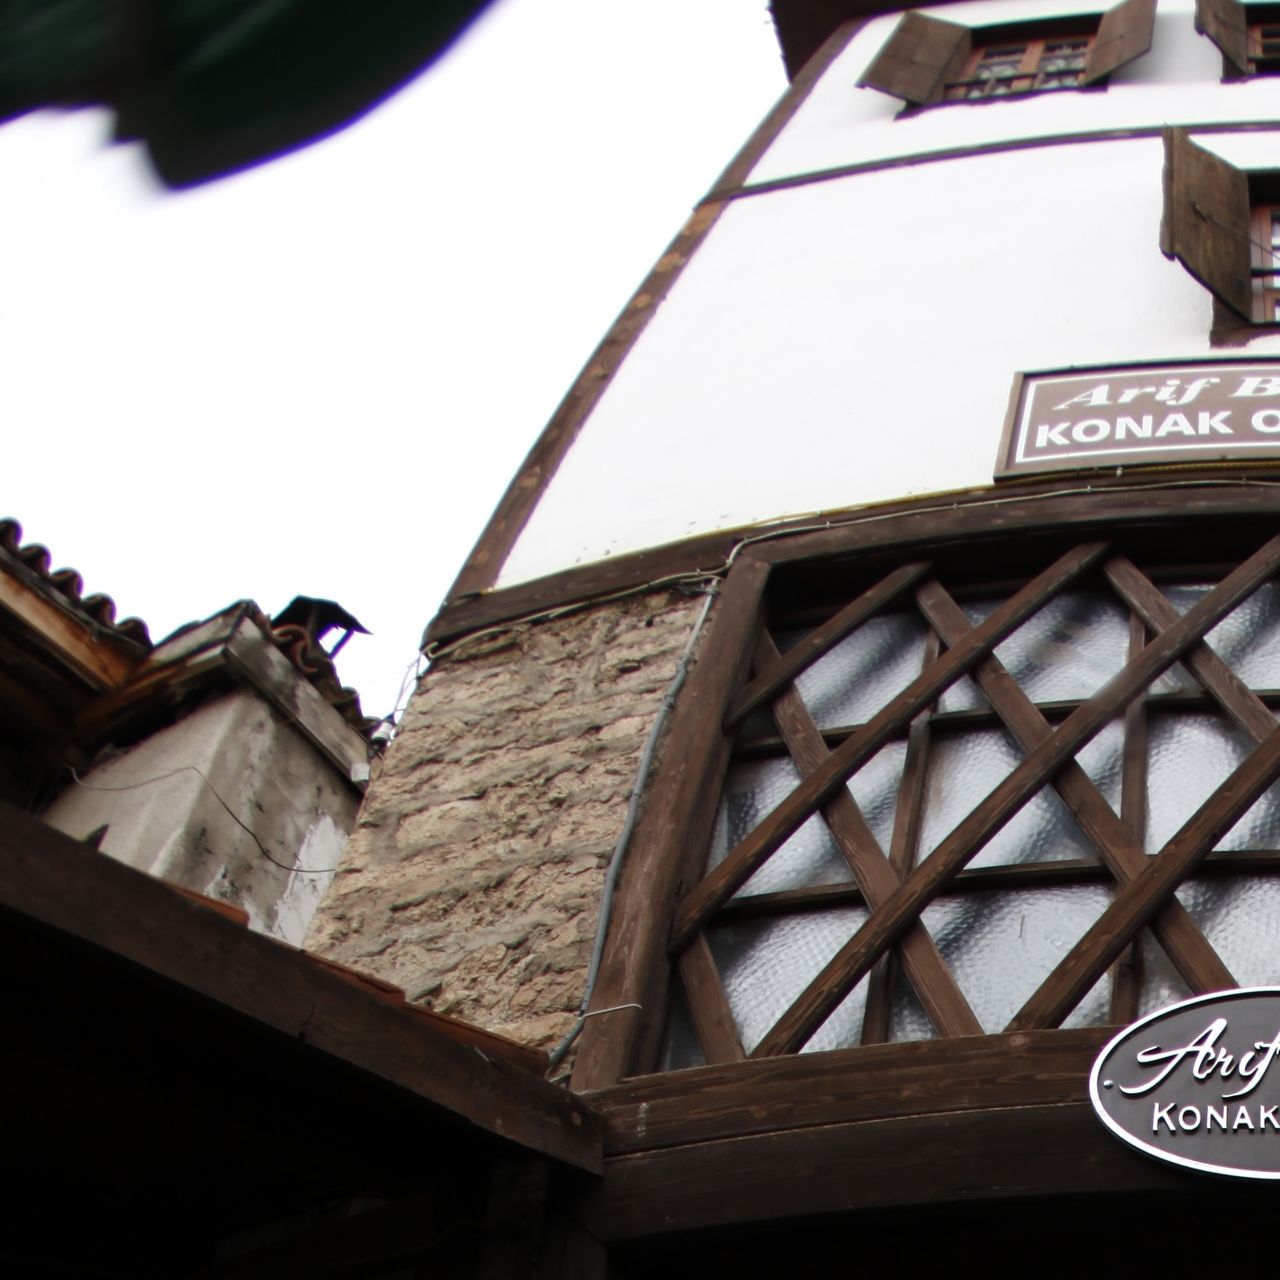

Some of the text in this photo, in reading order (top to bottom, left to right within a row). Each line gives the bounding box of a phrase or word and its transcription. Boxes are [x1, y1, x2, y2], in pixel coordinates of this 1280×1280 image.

[1052, 375, 1220, 410] Arif
[1035, 410, 1235, 448] KONAK
[1152, 1101, 1280, 1132] KONAK
